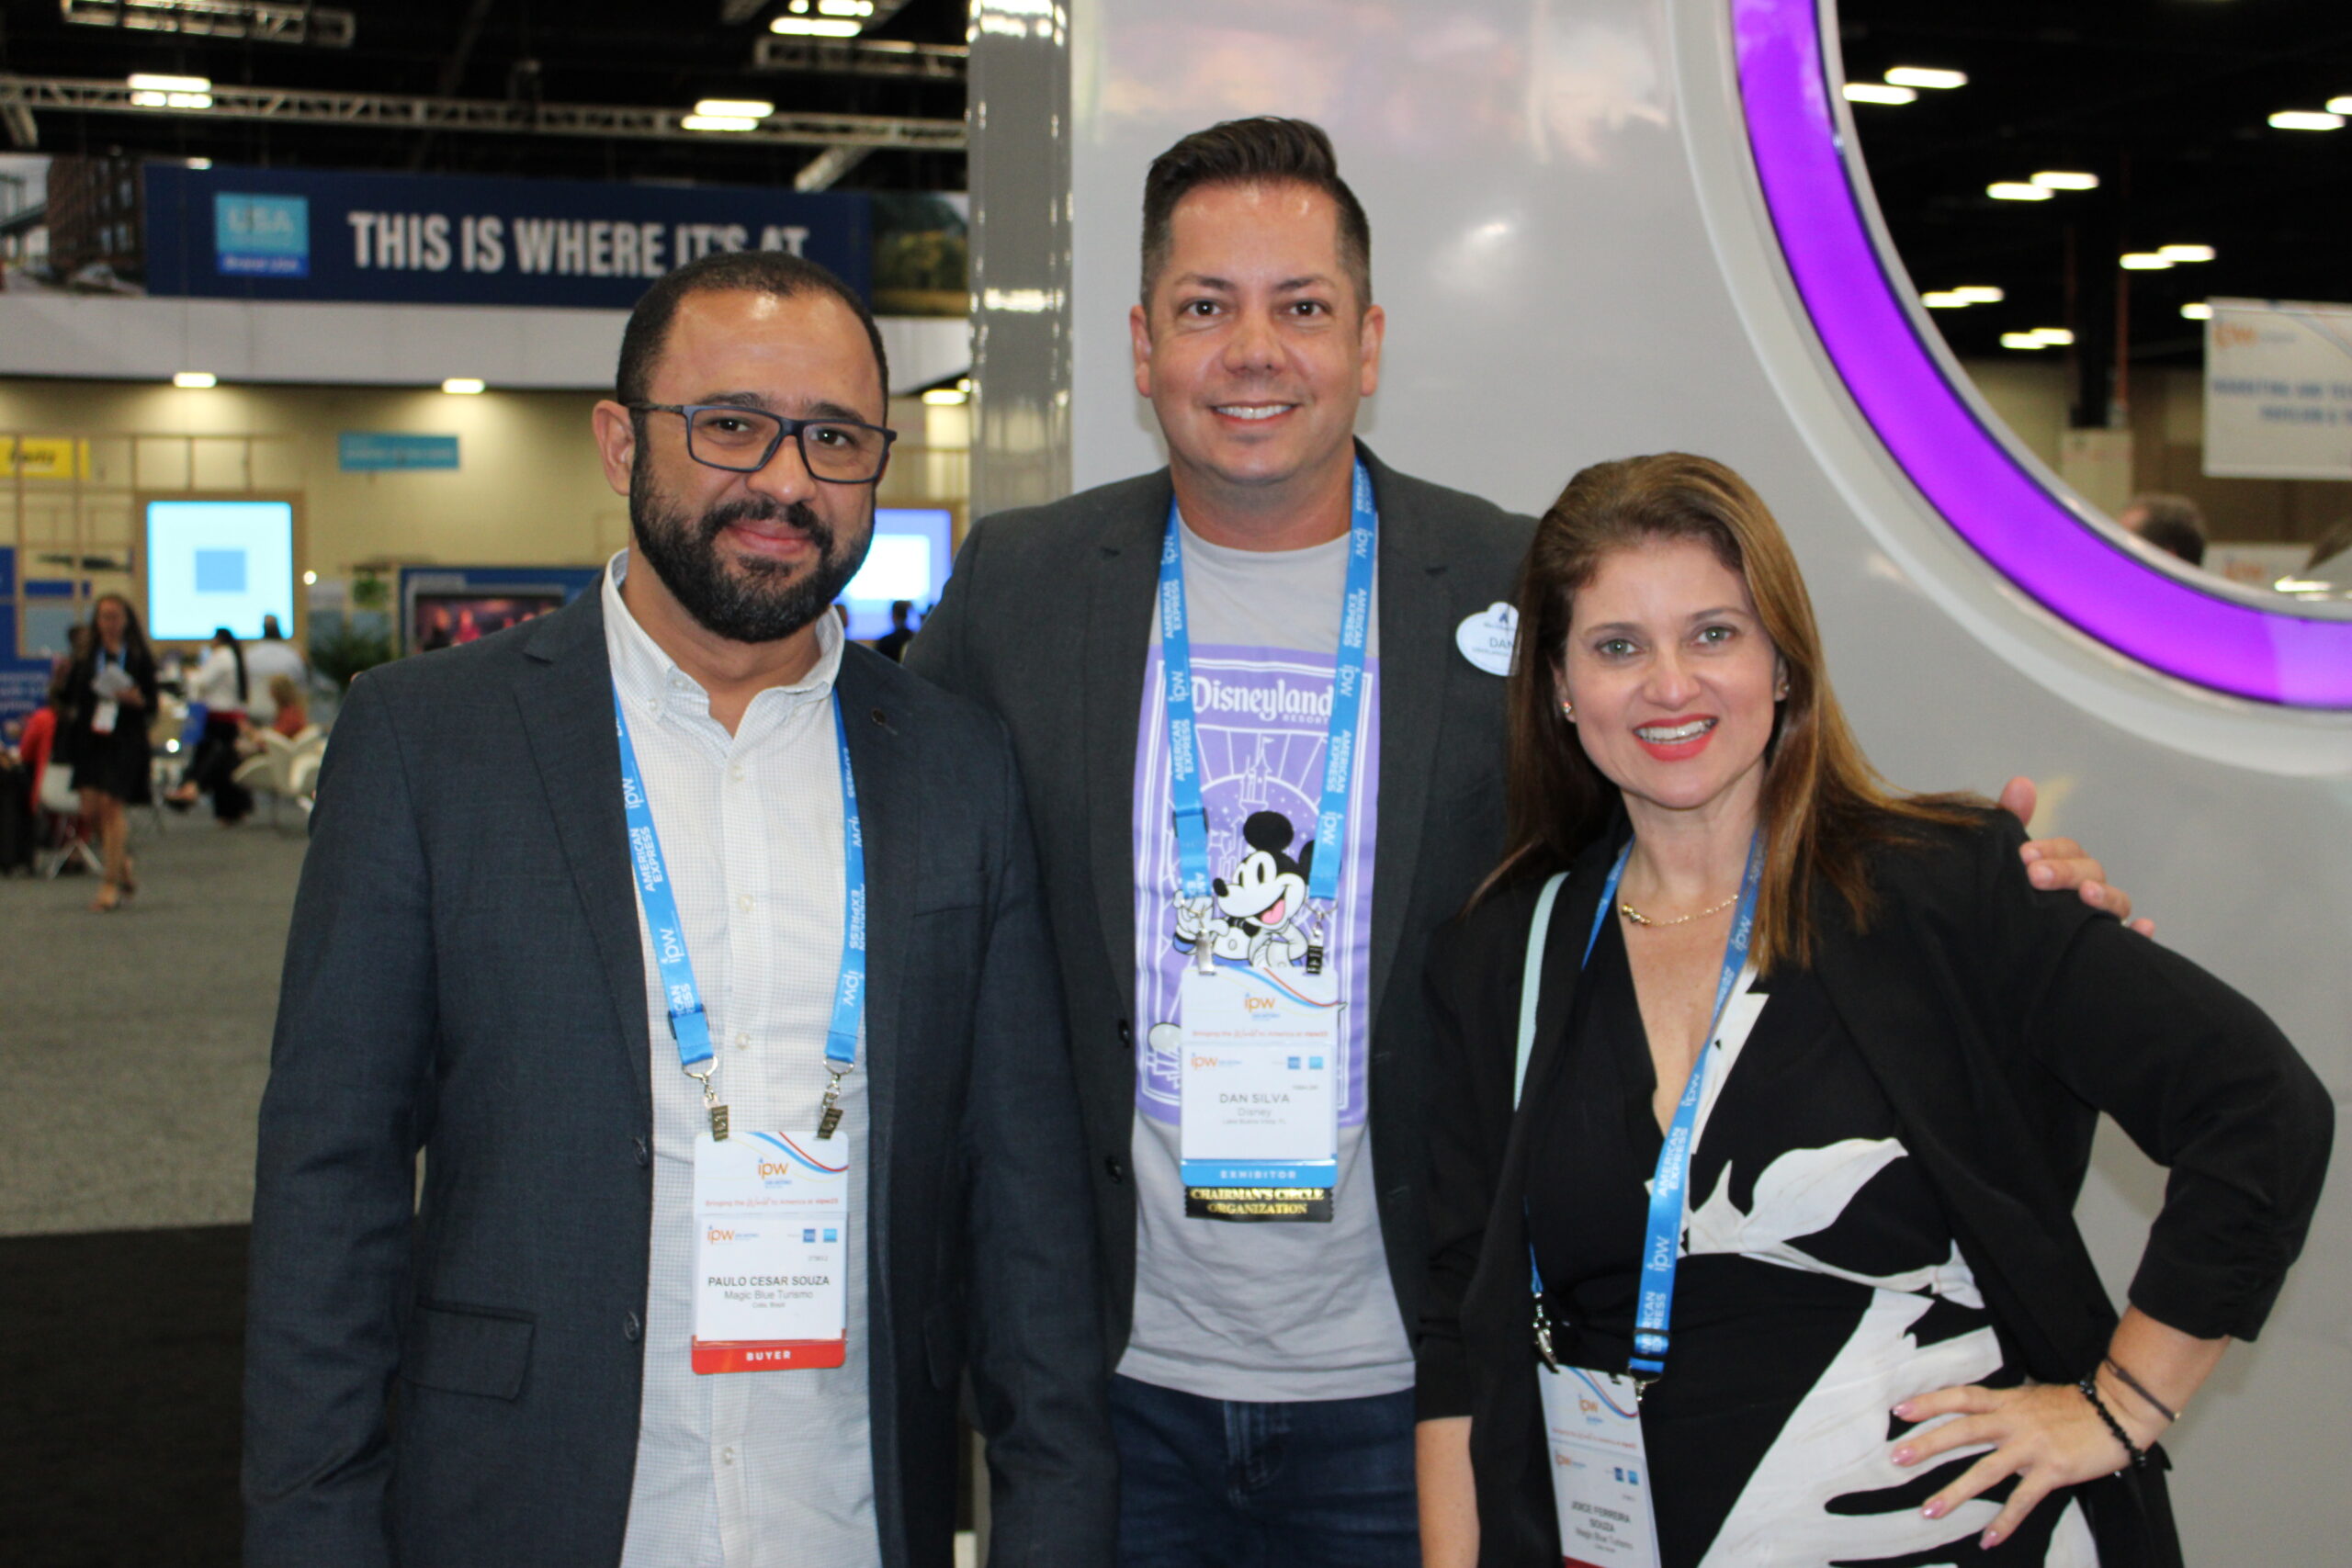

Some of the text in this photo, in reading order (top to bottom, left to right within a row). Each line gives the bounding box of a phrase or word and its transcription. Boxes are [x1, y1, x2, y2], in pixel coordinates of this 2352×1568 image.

[346, 210, 451, 272] THIS
[461, 215, 505, 273] IS
[513, 218, 666, 276] WHERE
[1354, 527, 1374, 559] ipw
[1163, 580, 1175, 639] AMERICAN
[1170, 578, 1183, 631] EXPRESS
[1343, 592, 1358, 647] EXPRESS
[1352, 587, 1367, 649] AMERICAN
[1168, 671, 1190, 703] ipw
[1340, 664, 1362, 697] ipw
[1191, 677, 1334, 722] Disneyland
[1282, 713, 1329, 725] RESORT
[1171, 719, 1187, 782] AMERICAN
[1180, 718, 1194, 774] EXPRESS
[1336, 729, 1352, 794] AMERICAN
[1326, 736, 1341, 793] EXPRESS
[621, 777, 645, 809] ipw
[1321, 810, 1345, 846] ipw
[631, 828, 656, 893] AMERICAN
[642, 826, 662, 884] EXPRESS
[849, 889, 862, 949] EXPRESS
[659, 928, 685, 964] ipw
[842, 970, 865, 1007] ipw
[1244, 993, 1276, 1012] ipw
[1191, 1054, 1218, 1070] ipw
[1219, 1093, 1291, 1103] DAN SILVA
[1680, 1074, 1701, 1108] ipw
[1238, 1108, 1272, 1118] Disney
[757, 1157, 789, 1180] ipw
[1220, 1169, 1297, 1179] EXHIBITOR
[1657, 1126, 1682, 1198] AMERICAN
[1668, 1126, 1689, 1190] EXPRESS
[1190, 1188, 1325, 1201] CHAIRMAN'S CIRCLE
[1207, 1202, 1308, 1214] ORGANIZATION
[707, 1225, 735, 1245] ipw
[1646, 1235, 1673, 1272] ipw
[708, 1275, 830, 1287] PAULO CESAR SOUZA
[724, 1290, 814, 1302] Magic Blue Turismo
[746, 1350, 792, 1361] BUYER
